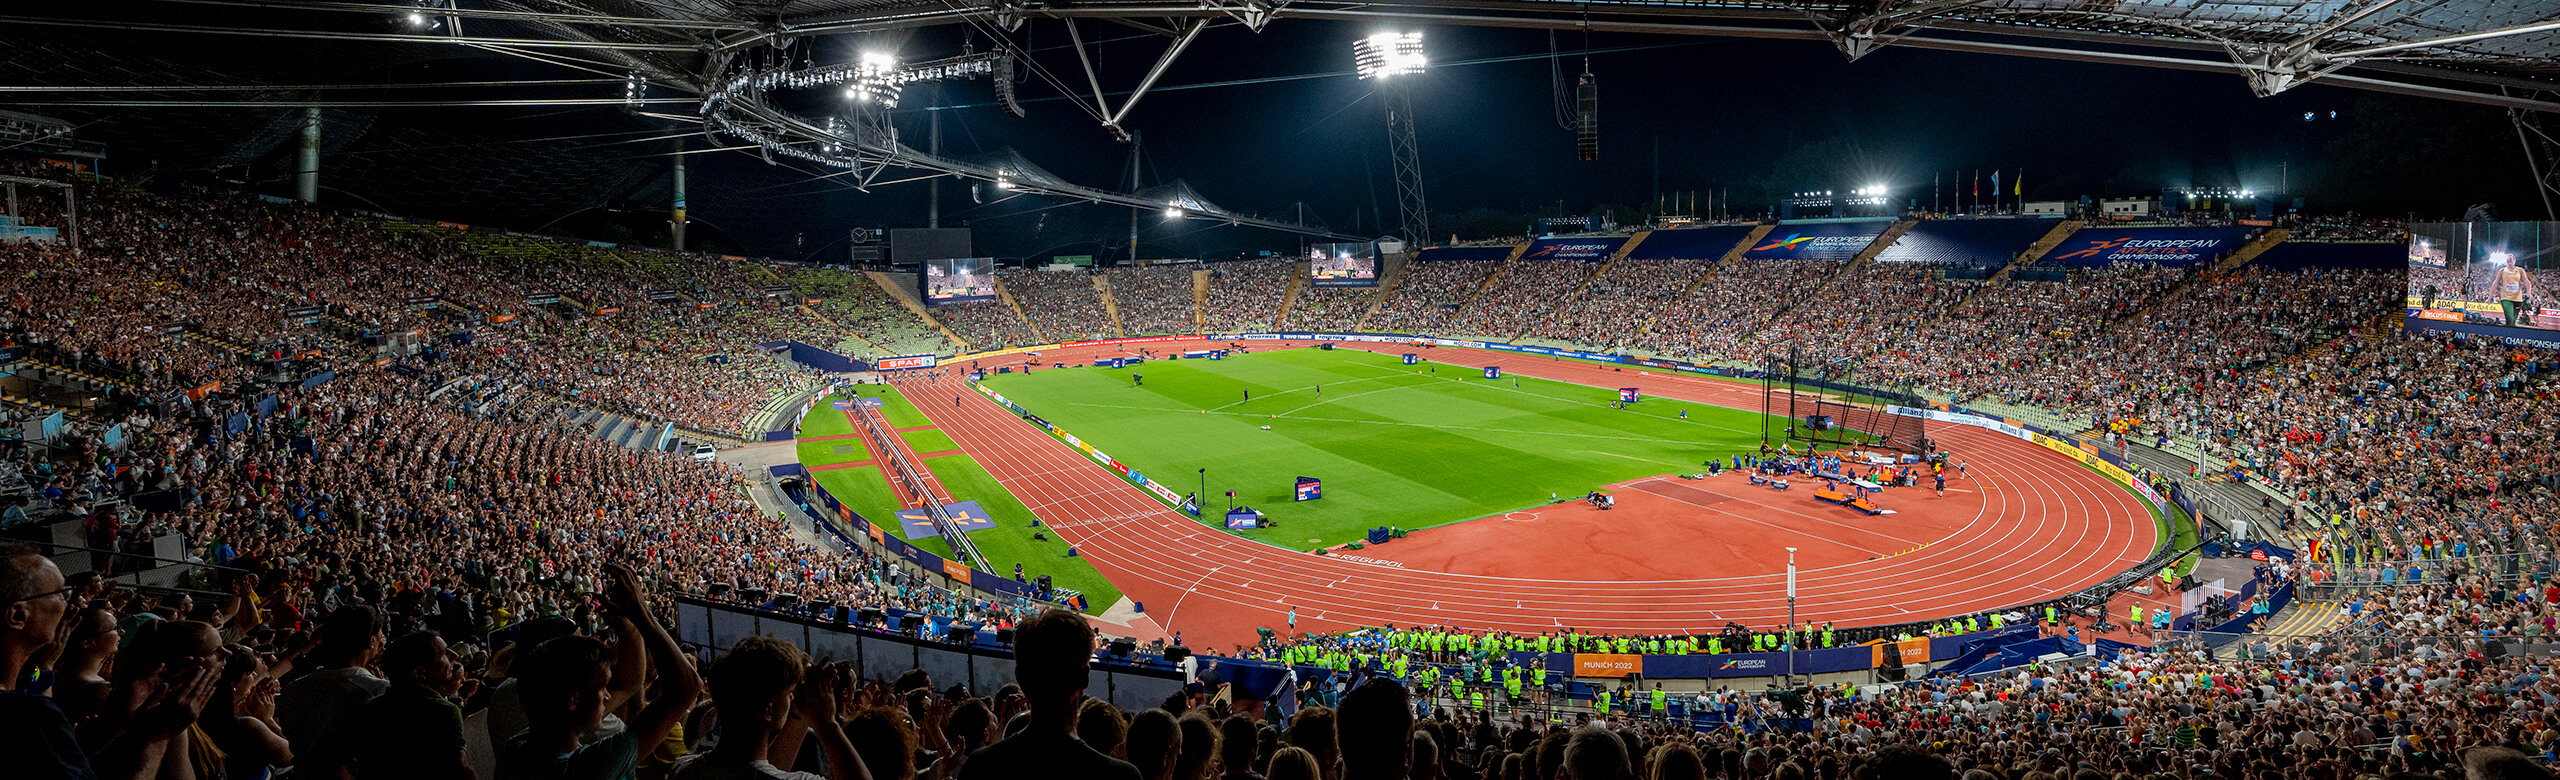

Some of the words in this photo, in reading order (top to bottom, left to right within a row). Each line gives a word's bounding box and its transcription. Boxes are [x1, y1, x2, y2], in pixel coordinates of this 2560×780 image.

[2123, 239, 2221, 248] EUROPEAN
[2437, 301, 2456, 309] ADAC
[889, 358, 921, 367] SPAR
[1897, 406, 1923, 416] Allianz
[1999, 423, 2018, 435] Allianz
[2034, 433, 2048, 446] ADAC
[2085, 454, 2099, 467] ADAC
[1340, 554, 1406, 569] REGUPOL
[1907, 648, 1922, 656] 2022
[1583, 661, 1613, 669] MUNICH
